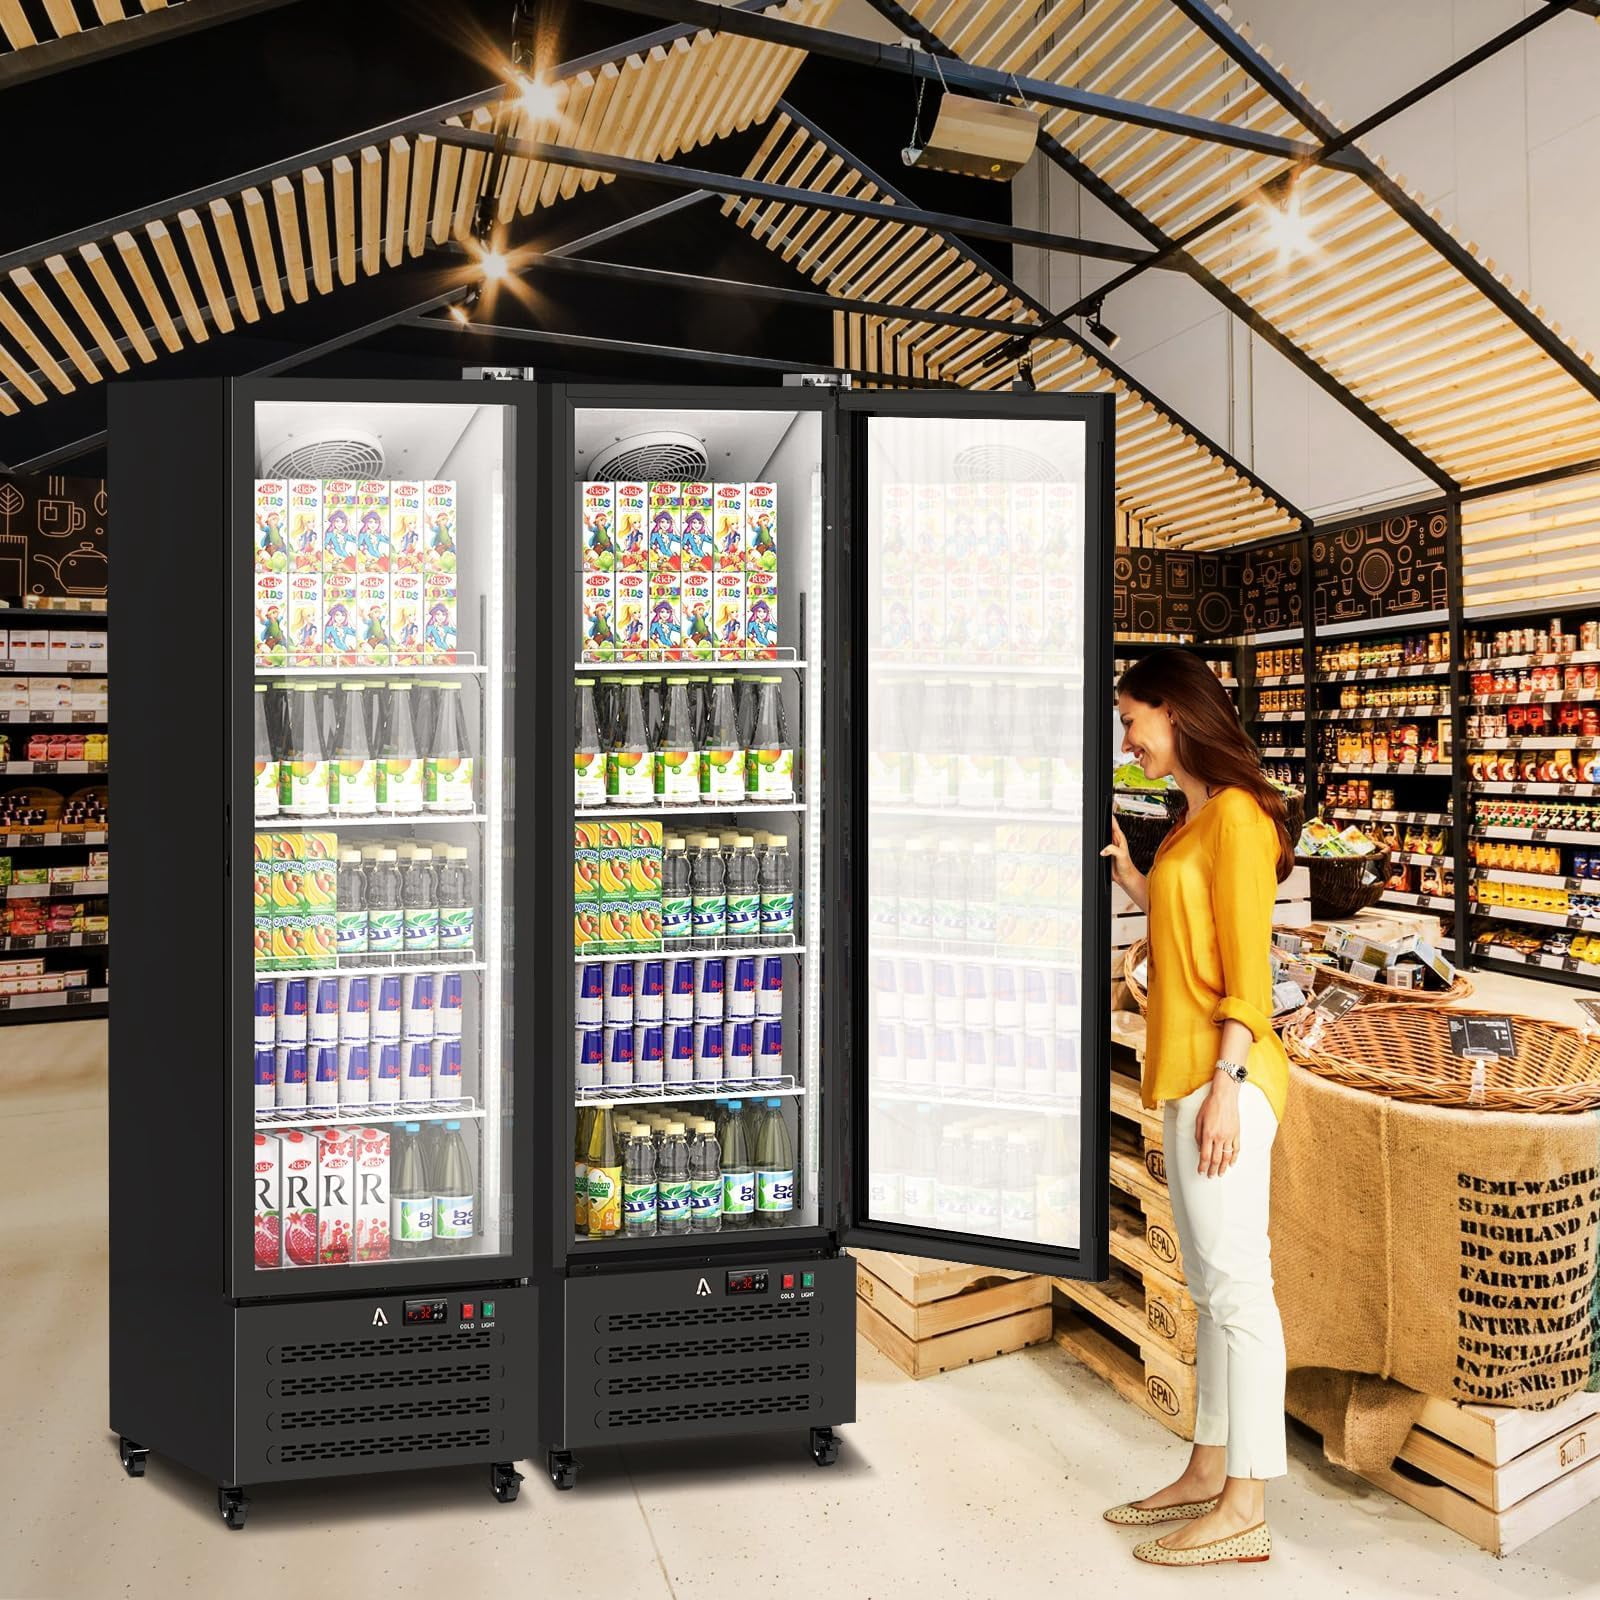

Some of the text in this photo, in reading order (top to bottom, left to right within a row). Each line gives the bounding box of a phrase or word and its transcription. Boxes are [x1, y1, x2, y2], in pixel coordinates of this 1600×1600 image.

[255, 1178, 275, 1211] R
[286, 1176, 312, 1209] R
[324, 1175, 349, 1207] R
[360, 1174, 385, 1205] R
[1458, 1194, 1584, 1220] SUMATERA
[1151, 1230, 1173, 1259] EPAL
[1460, 1218, 1581, 1243] HIGHLAND
[1460, 1240, 1493, 1261] DP
[1499, 1243, 1576, 1266] GRADE
[1460, 1260, 1589, 1289] FAIRTRADE
[780, 1292, 795, 1300] COLD
[1458, 1287, 1566, 1310] ORGANIC
[481, 1321, 495, 1329] LIGHT
[1148, 1303, 1173, 1332] EPAL
[1151, 1382, 1175, 1411] EPAL
